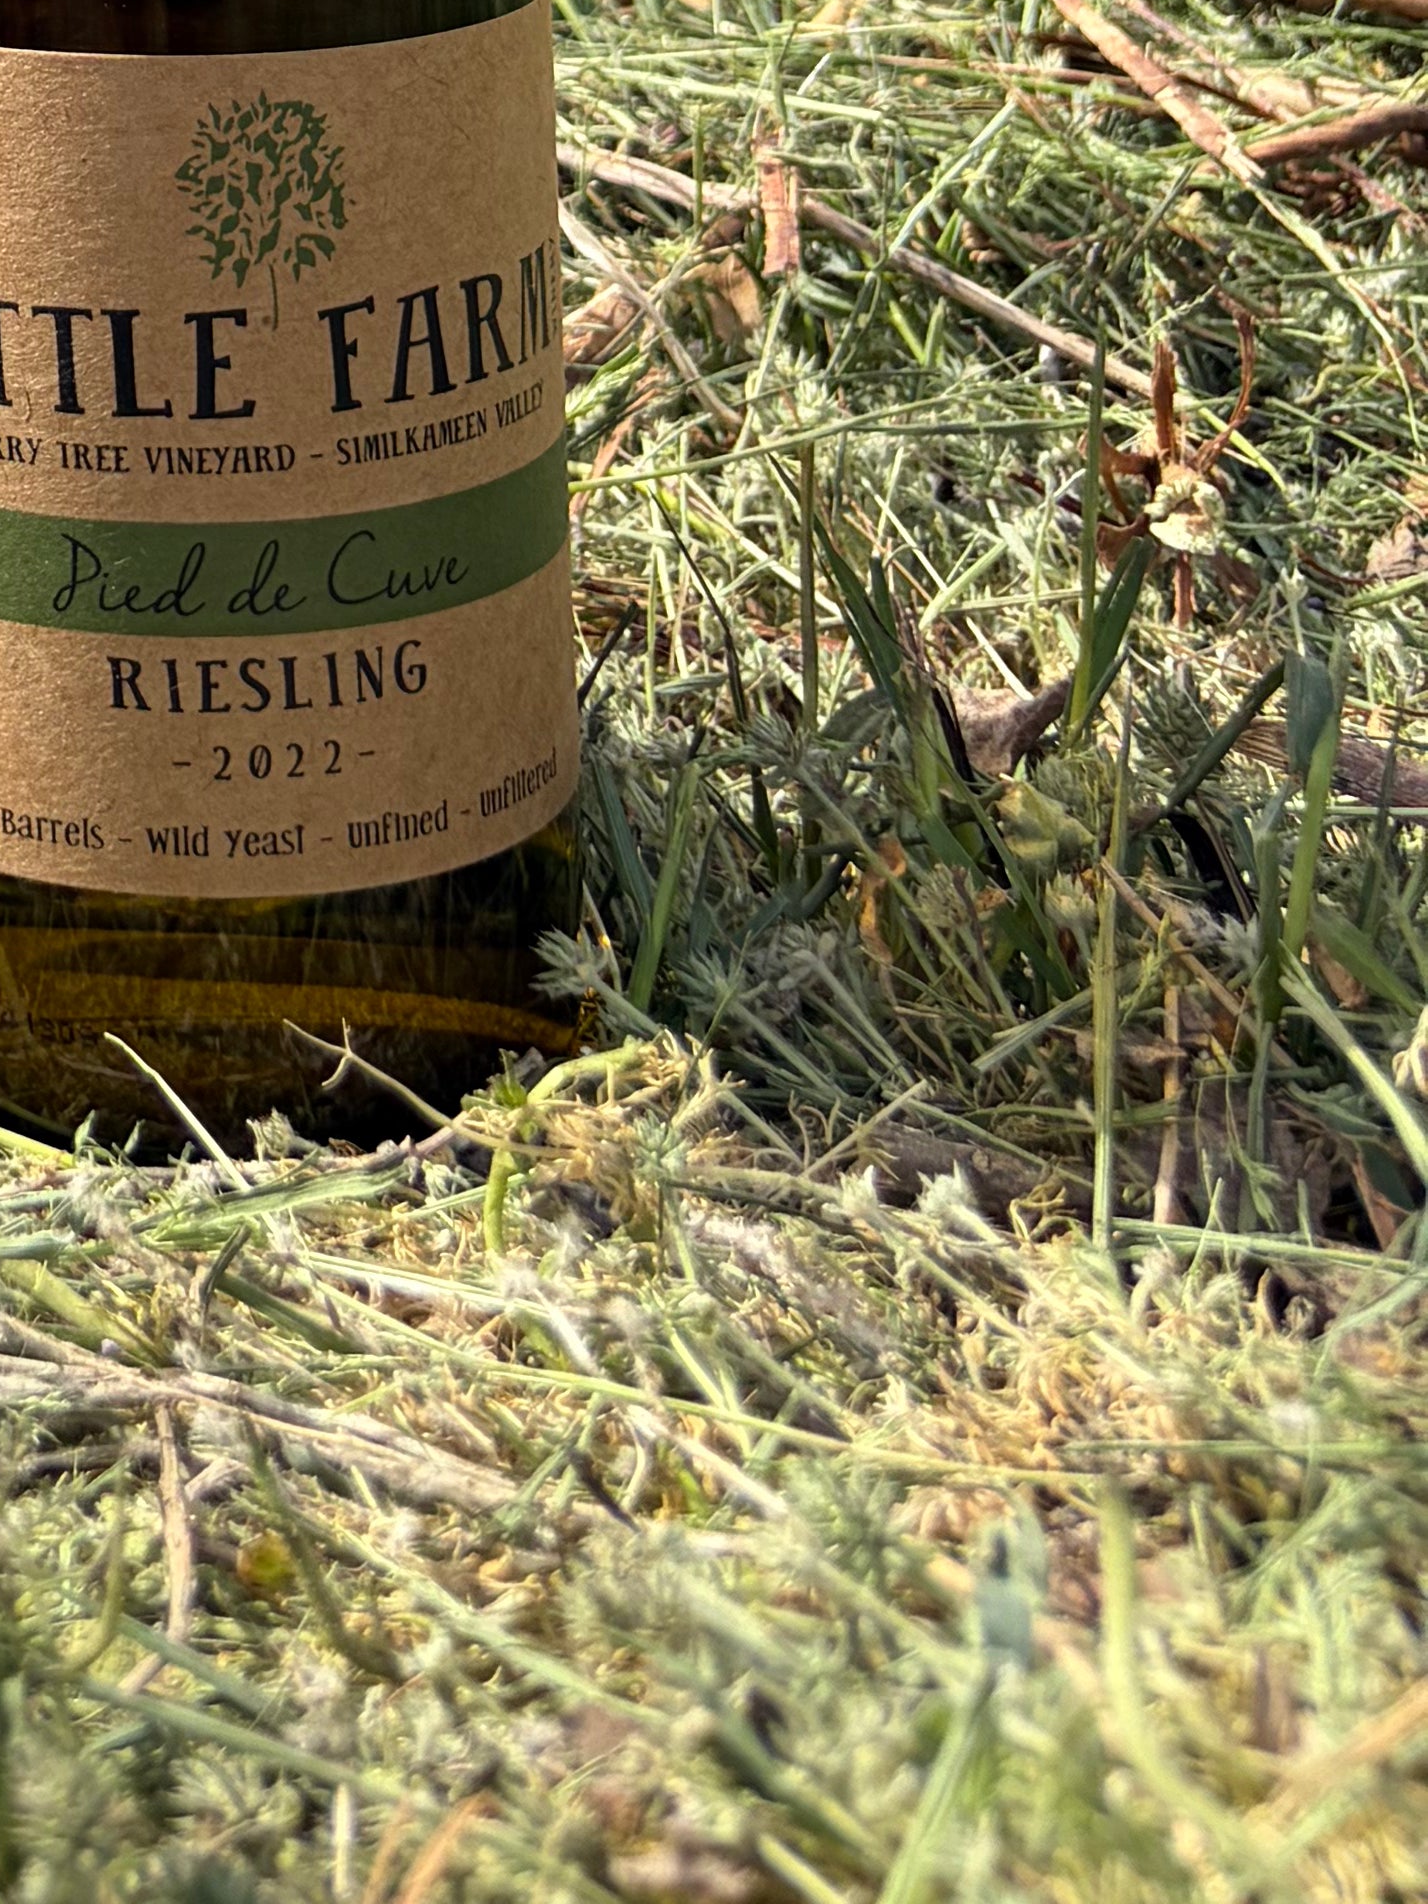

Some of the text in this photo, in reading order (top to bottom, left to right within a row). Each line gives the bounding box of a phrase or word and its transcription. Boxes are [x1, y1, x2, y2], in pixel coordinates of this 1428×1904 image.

[317, 240, 551, 413] FARM
[56, 441, 130, 473] TREE
[144, 444, 295, 475] VINEYARD
[336, 408, 488, 465] SIMILKAMEEN
[495, 378, 544, 428] VALLEY
[52, 529, 471, 617] Pied de Cuve
[106, 639, 428, 714] RIESLING
[0, 807, 105, 850] Barrels
